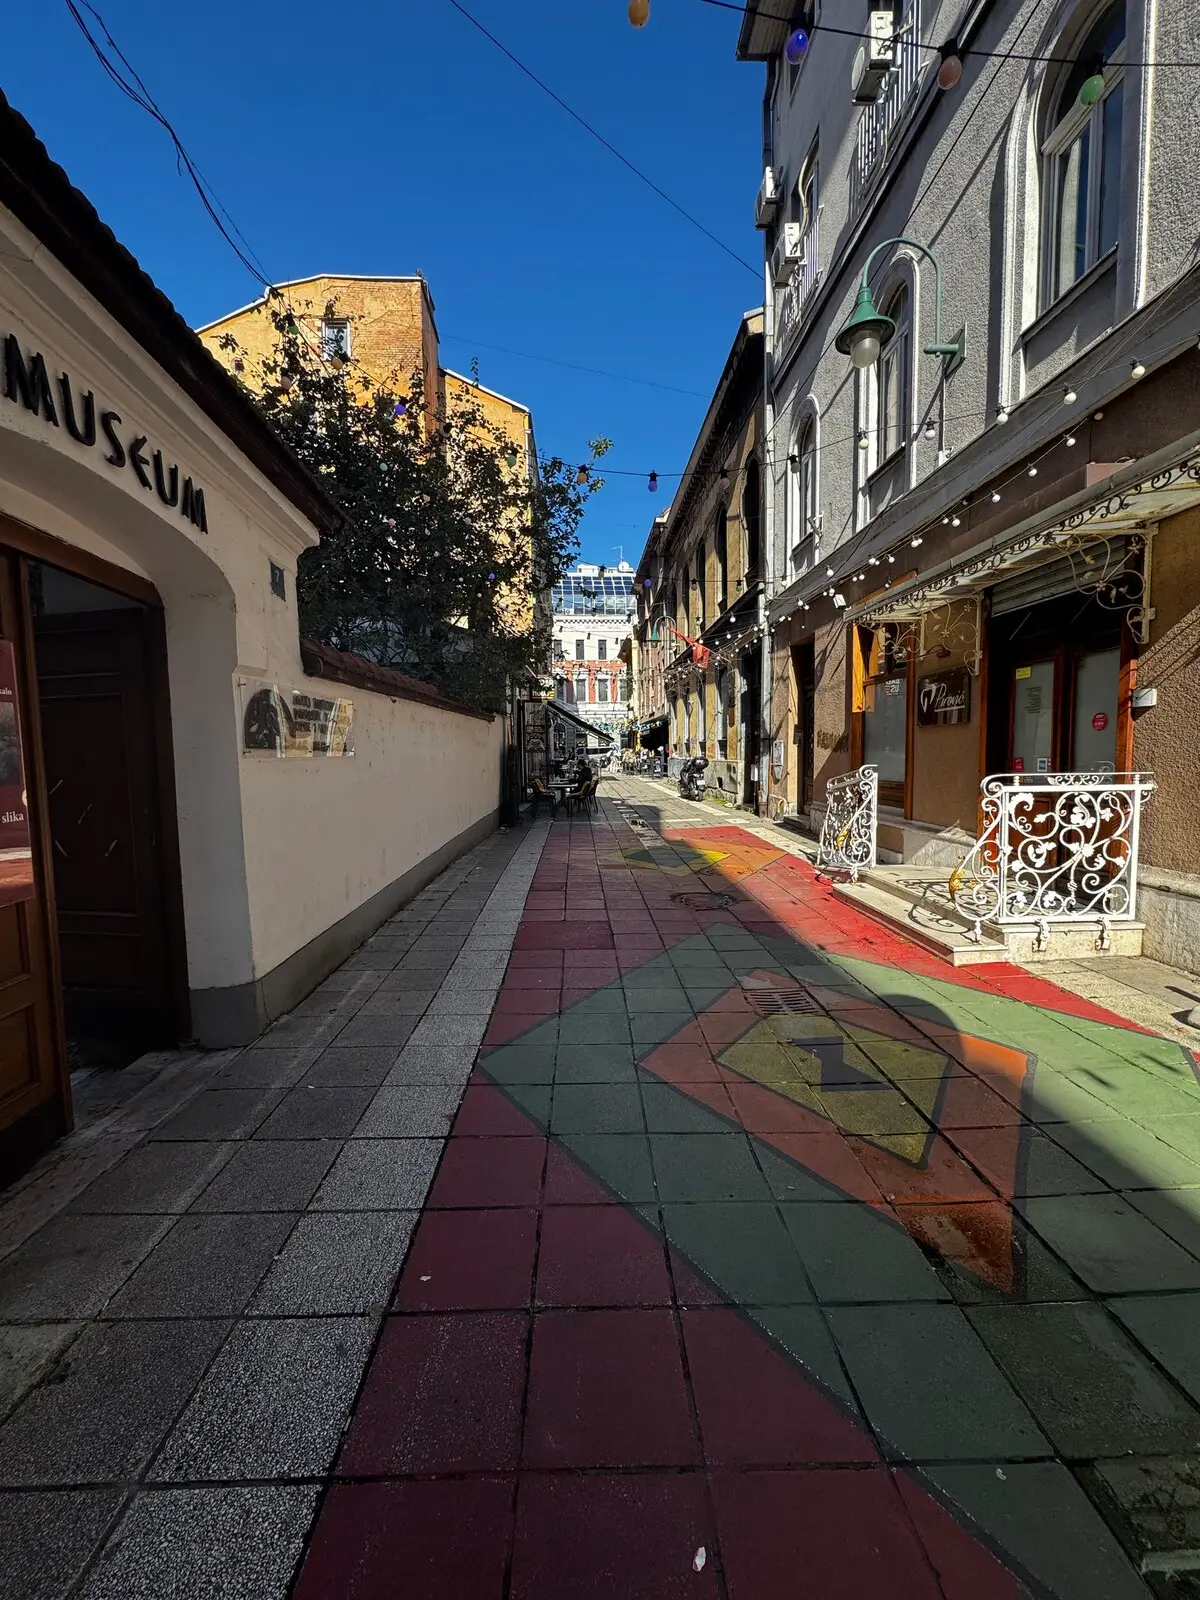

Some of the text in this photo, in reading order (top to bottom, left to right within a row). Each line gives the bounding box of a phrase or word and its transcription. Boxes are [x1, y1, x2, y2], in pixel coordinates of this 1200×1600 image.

[3, 333, 209, 535] MUSEUM
[274, 569, 280, 583] 7
[1, 810, 25, 824] slika
